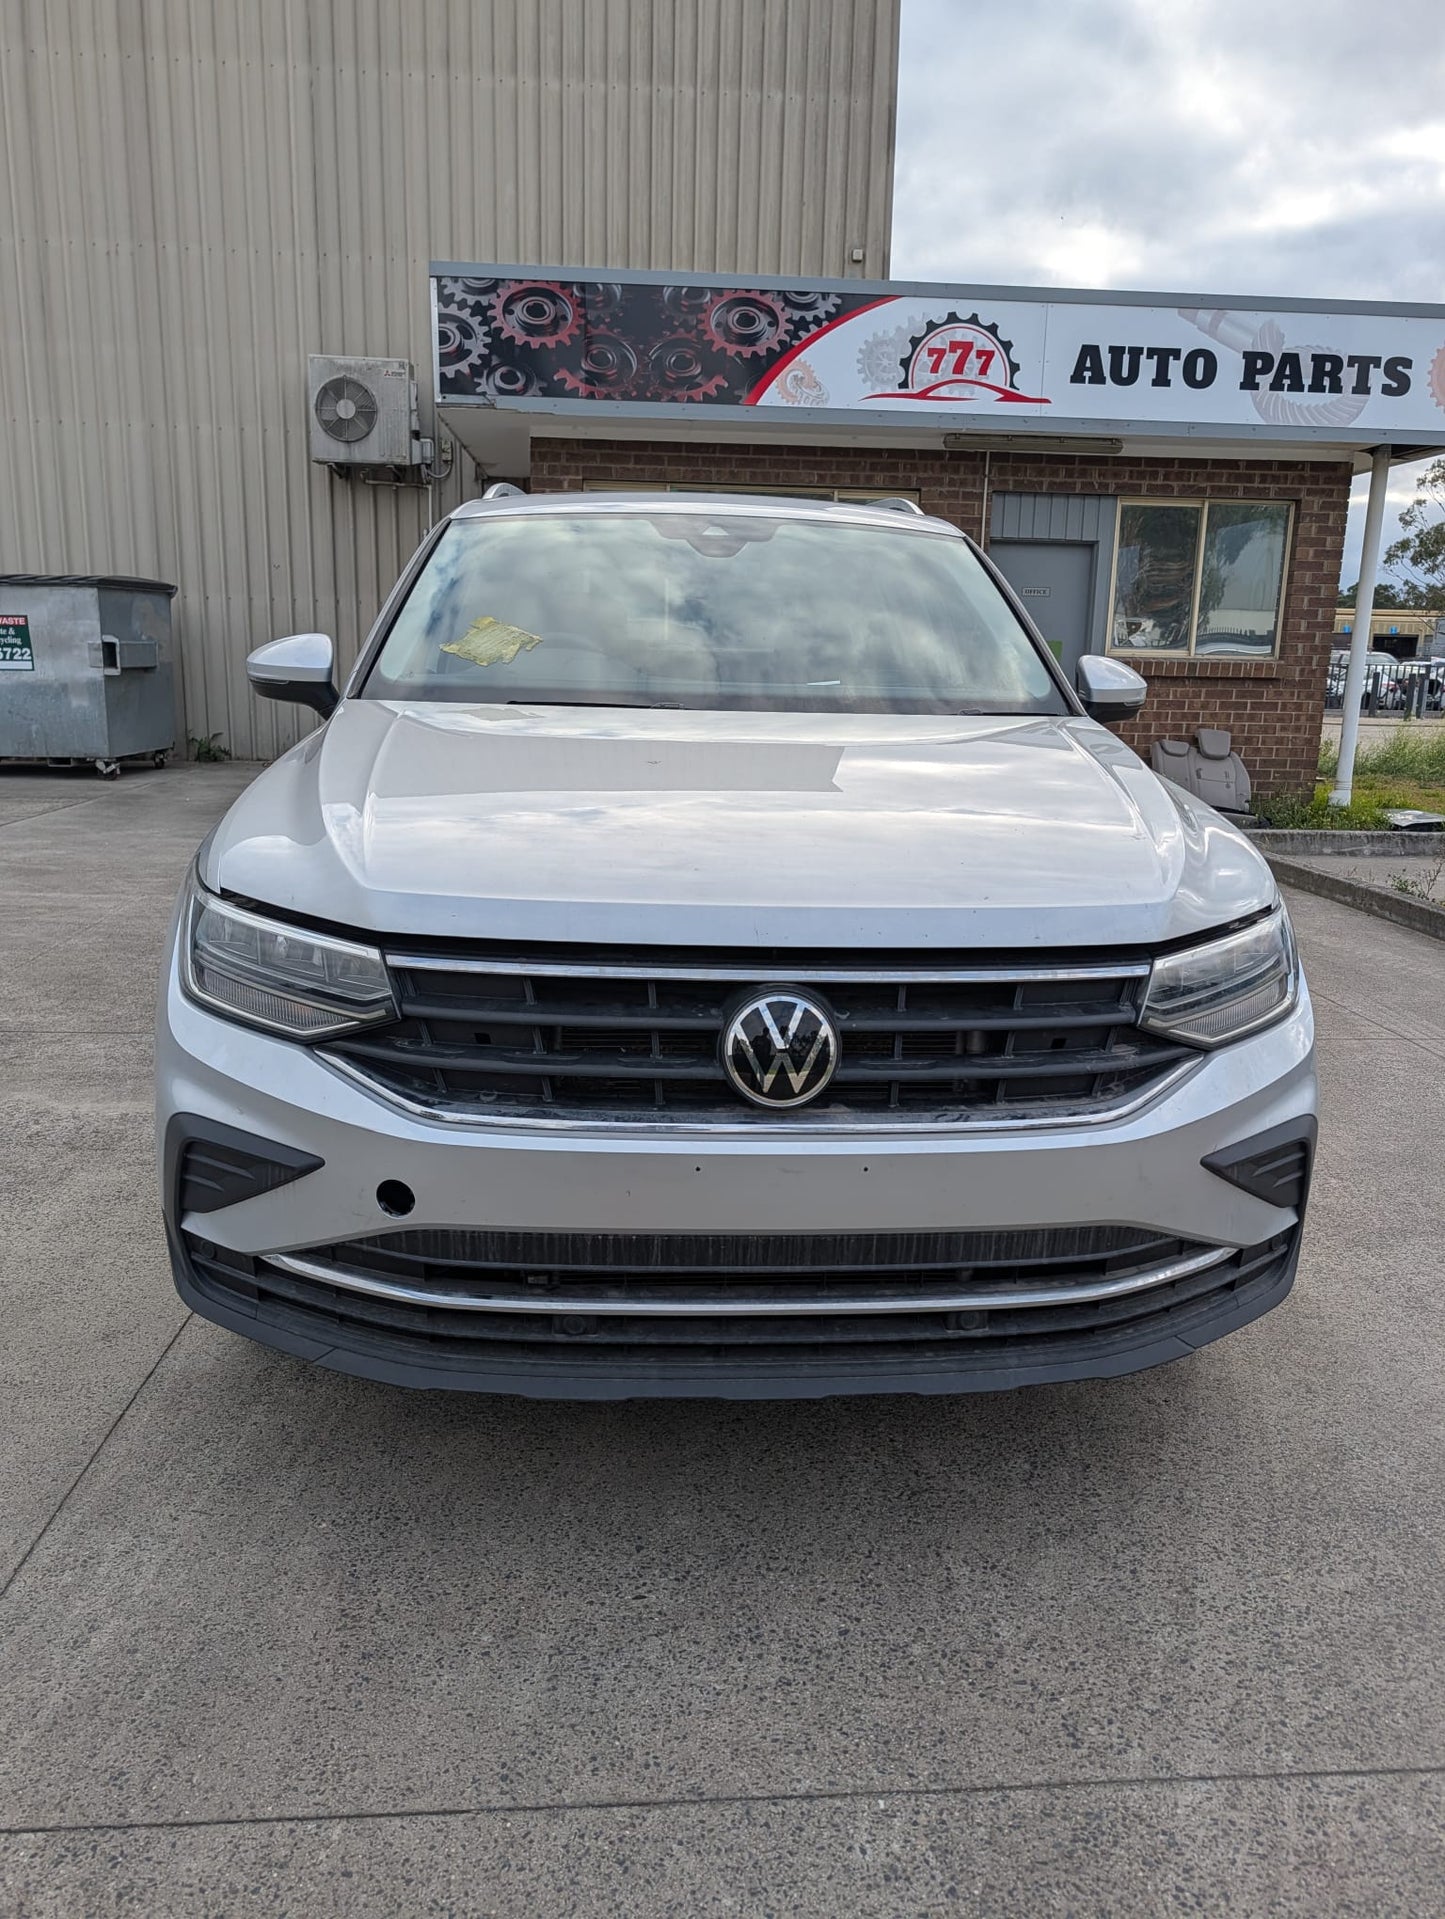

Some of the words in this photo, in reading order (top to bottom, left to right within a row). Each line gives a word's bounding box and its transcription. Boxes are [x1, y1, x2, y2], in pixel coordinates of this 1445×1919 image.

[927, 341, 995, 376] 777
[1069, 344, 1218, 390] AUTO
[1239, 351, 1413, 397] PARTS
[0, 617, 25, 625] ASTE
